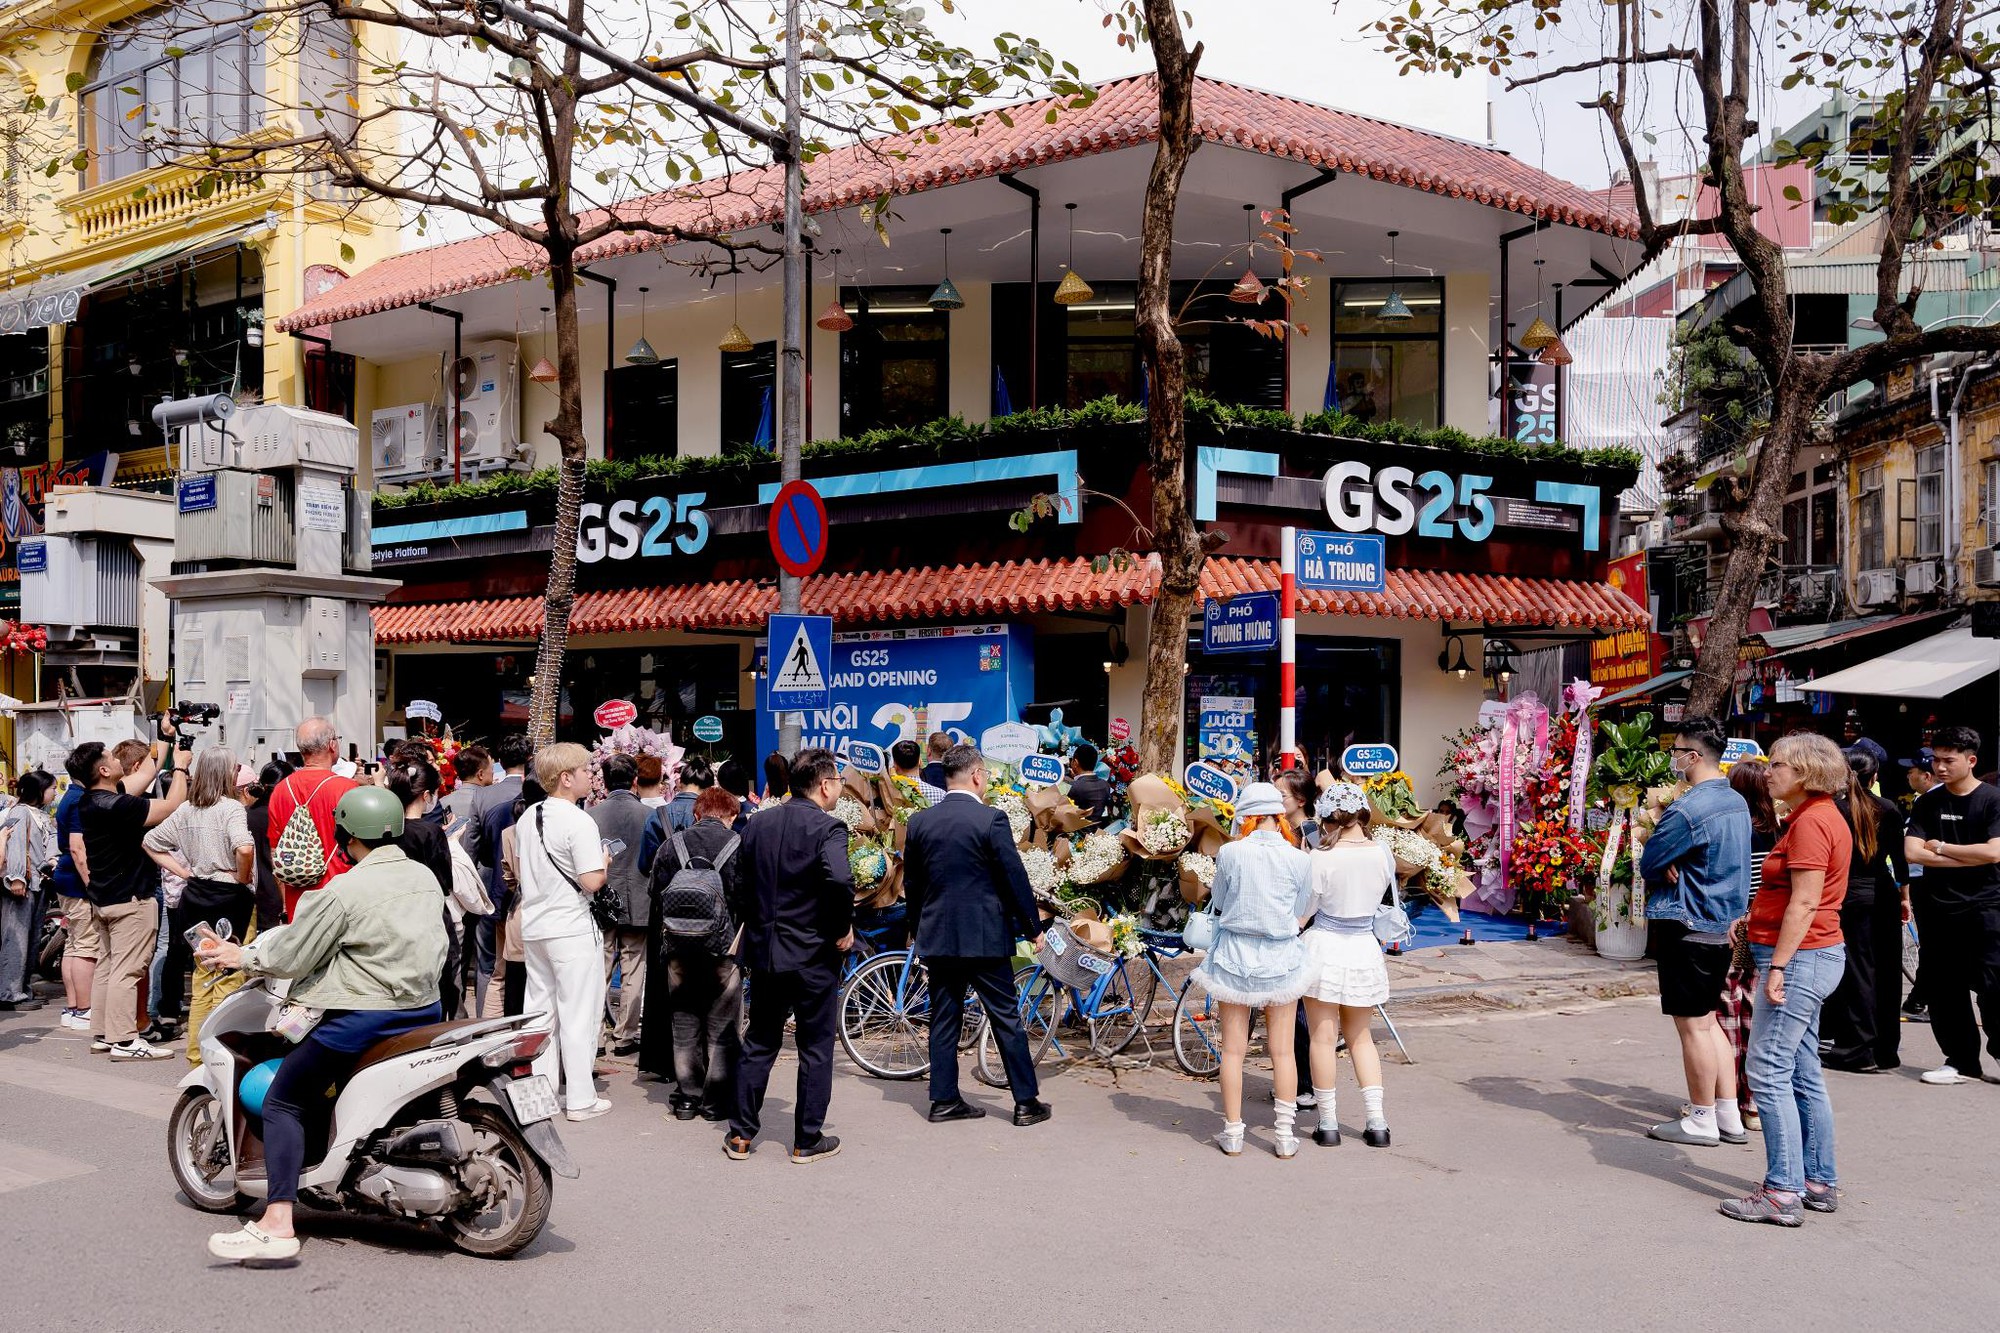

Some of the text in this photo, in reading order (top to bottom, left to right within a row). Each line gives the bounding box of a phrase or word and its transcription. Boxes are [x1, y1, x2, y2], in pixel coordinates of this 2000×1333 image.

[1515, 384, 1555, 412] GS
[1515, 414, 1555, 443] 25
[1322, 460, 1495, 541] GS25
[576, 492, 709, 563] GS25
[371, 546, 428, 562] estyle Platform
[1325, 541, 1355, 556] PHỐ
[1305, 556, 1376, 582] HÀ TRUNG
[1229, 601, 1253, 618] PHỐ
[1211, 620, 1272, 644] PHÙNG HƯNG
[850, 649, 890, 668] GS25
[830, 670, 937, 688] AND OPENING
[854, 746, 872, 757] GS25
[1208, 733, 1244, 755] 50%
[1726, 742, 1748, 751] GS25
[851, 757, 862, 766] XIN
[1031, 757, 1053, 768] GS25
[1356, 749, 1383, 760] GS25
[1721, 752, 1742, 760] IN CH
[1024, 767, 1038, 777] XIN
[1348, 761, 1365, 769] XIN
[1190, 776, 1205, 790] XIN
[1200, 770, 1224, 787] GS25
[1046, 929, 1066, 954] GS25
[1080, 954, 1109, 973] GS25
[408, 1050, 461, 1069] VISION
